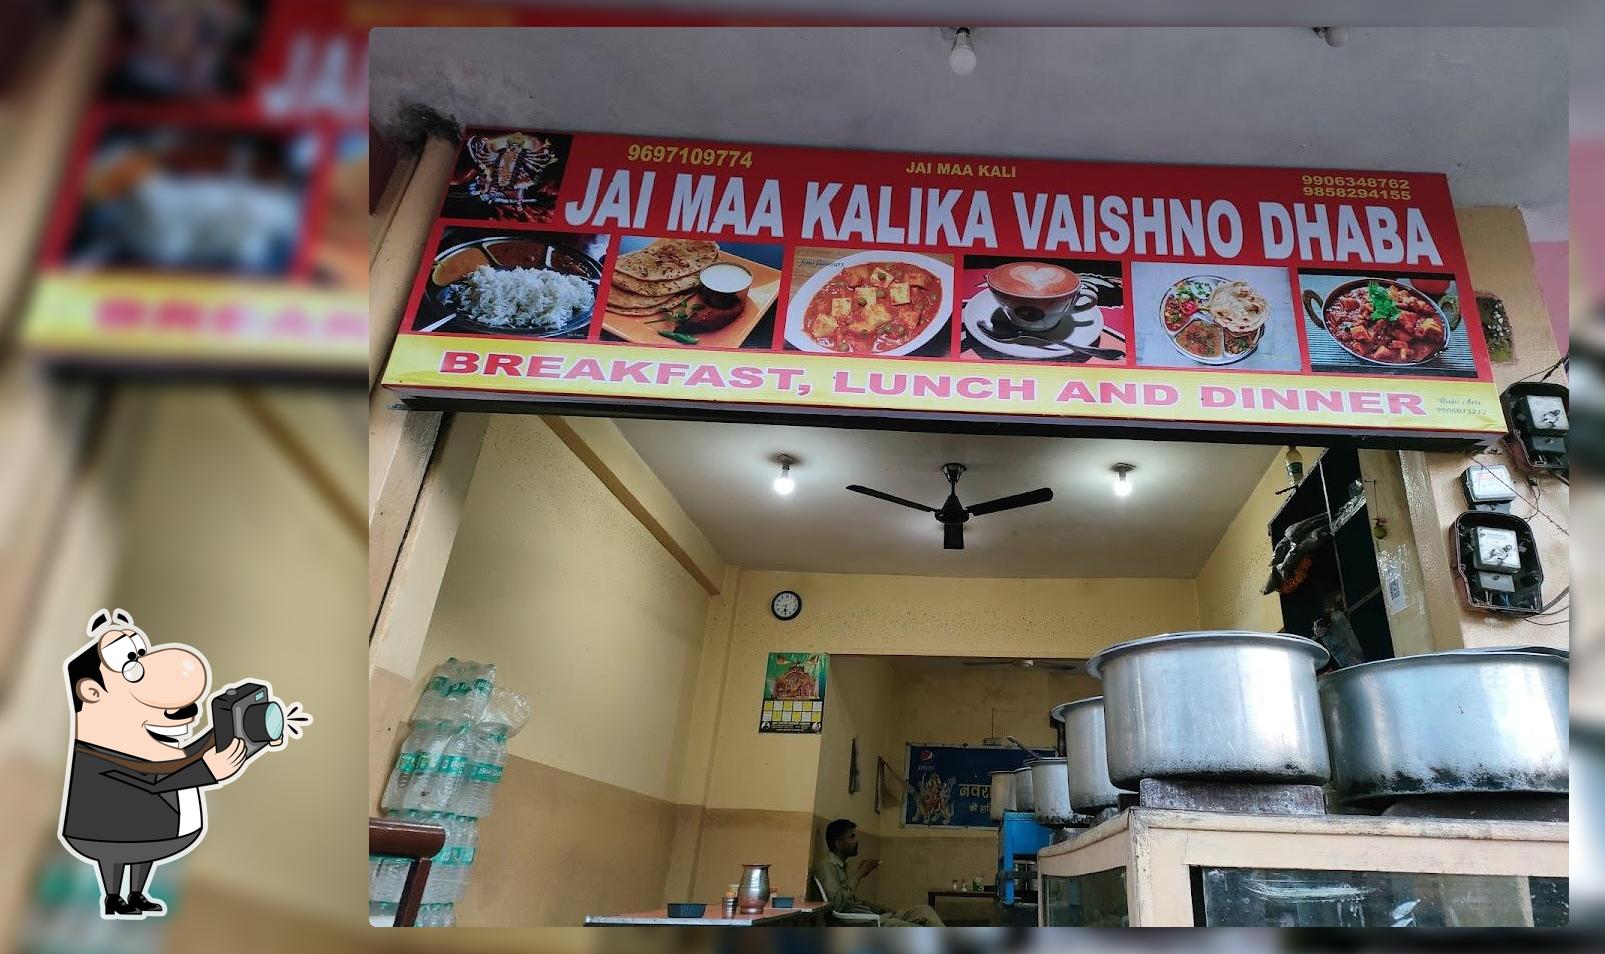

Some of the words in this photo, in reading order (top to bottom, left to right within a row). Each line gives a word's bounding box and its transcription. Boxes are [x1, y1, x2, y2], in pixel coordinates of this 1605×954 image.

[628, 144, 753, 168] 9697109774
[905, 161, 932, 174] JAI
[937, 163, 974, 176] MAA
[978, 164, 1016, 178] KALI
[1302, 175, 1410, 189] 9906348762
[1303, 186, 1412, 200] 9858294155
[565, 168, 656, 229] JAI
[667, 173, 784, 238] MAA
[801, 182, 998, 248] KALIKA
[1012, 192, 1243, 259] VAISHNO
[1259, 202, 1444, 266] DHABA
[439, 351, 813, 396] BREAKFAST,
[833, 371, 1039, 404] LUNCH
[1057, 380, 1182, 407] AND
[1199, 386, 1428, 415] DINNER
